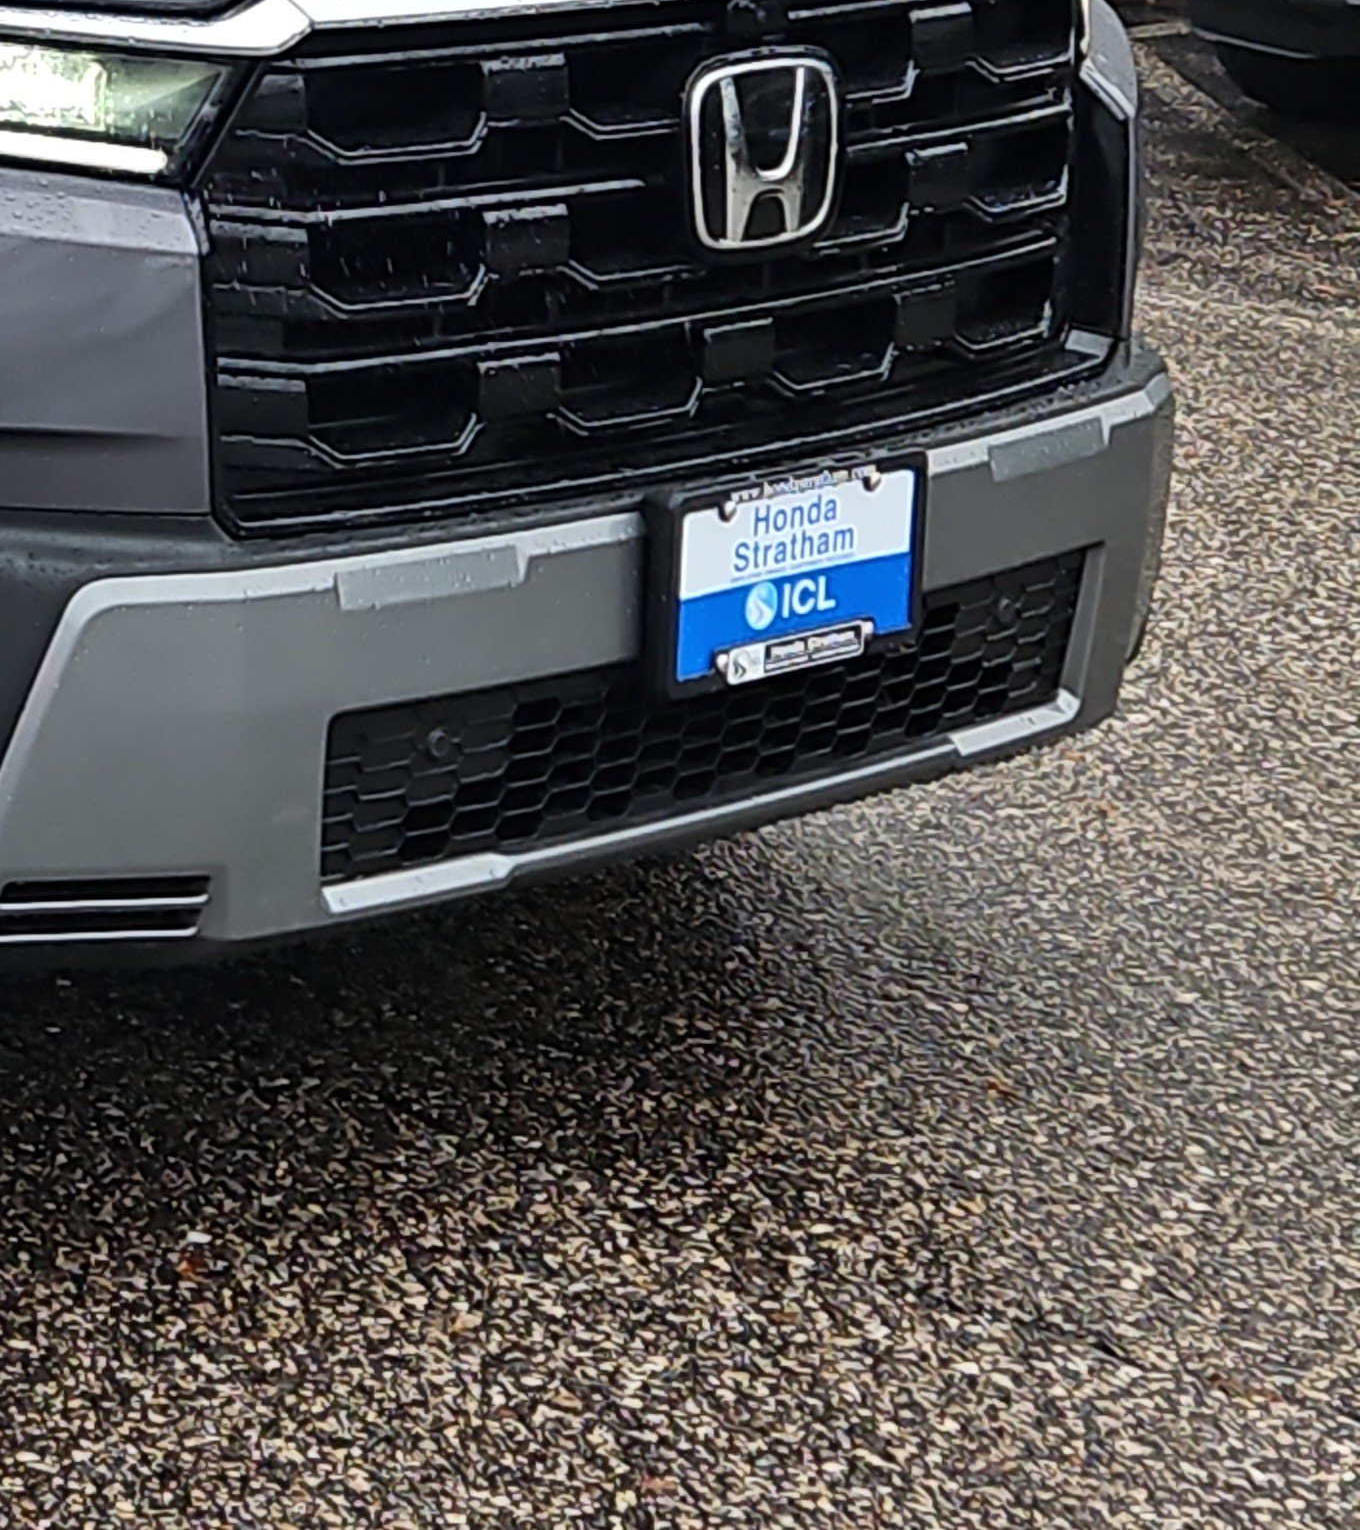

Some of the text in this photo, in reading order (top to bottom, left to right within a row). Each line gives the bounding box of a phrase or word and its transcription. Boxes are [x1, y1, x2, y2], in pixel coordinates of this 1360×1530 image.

[753, 494, 837, 537] Honda
[733, 526, 855, 573] Stratham
[782, 576, 837, 619] ICL
